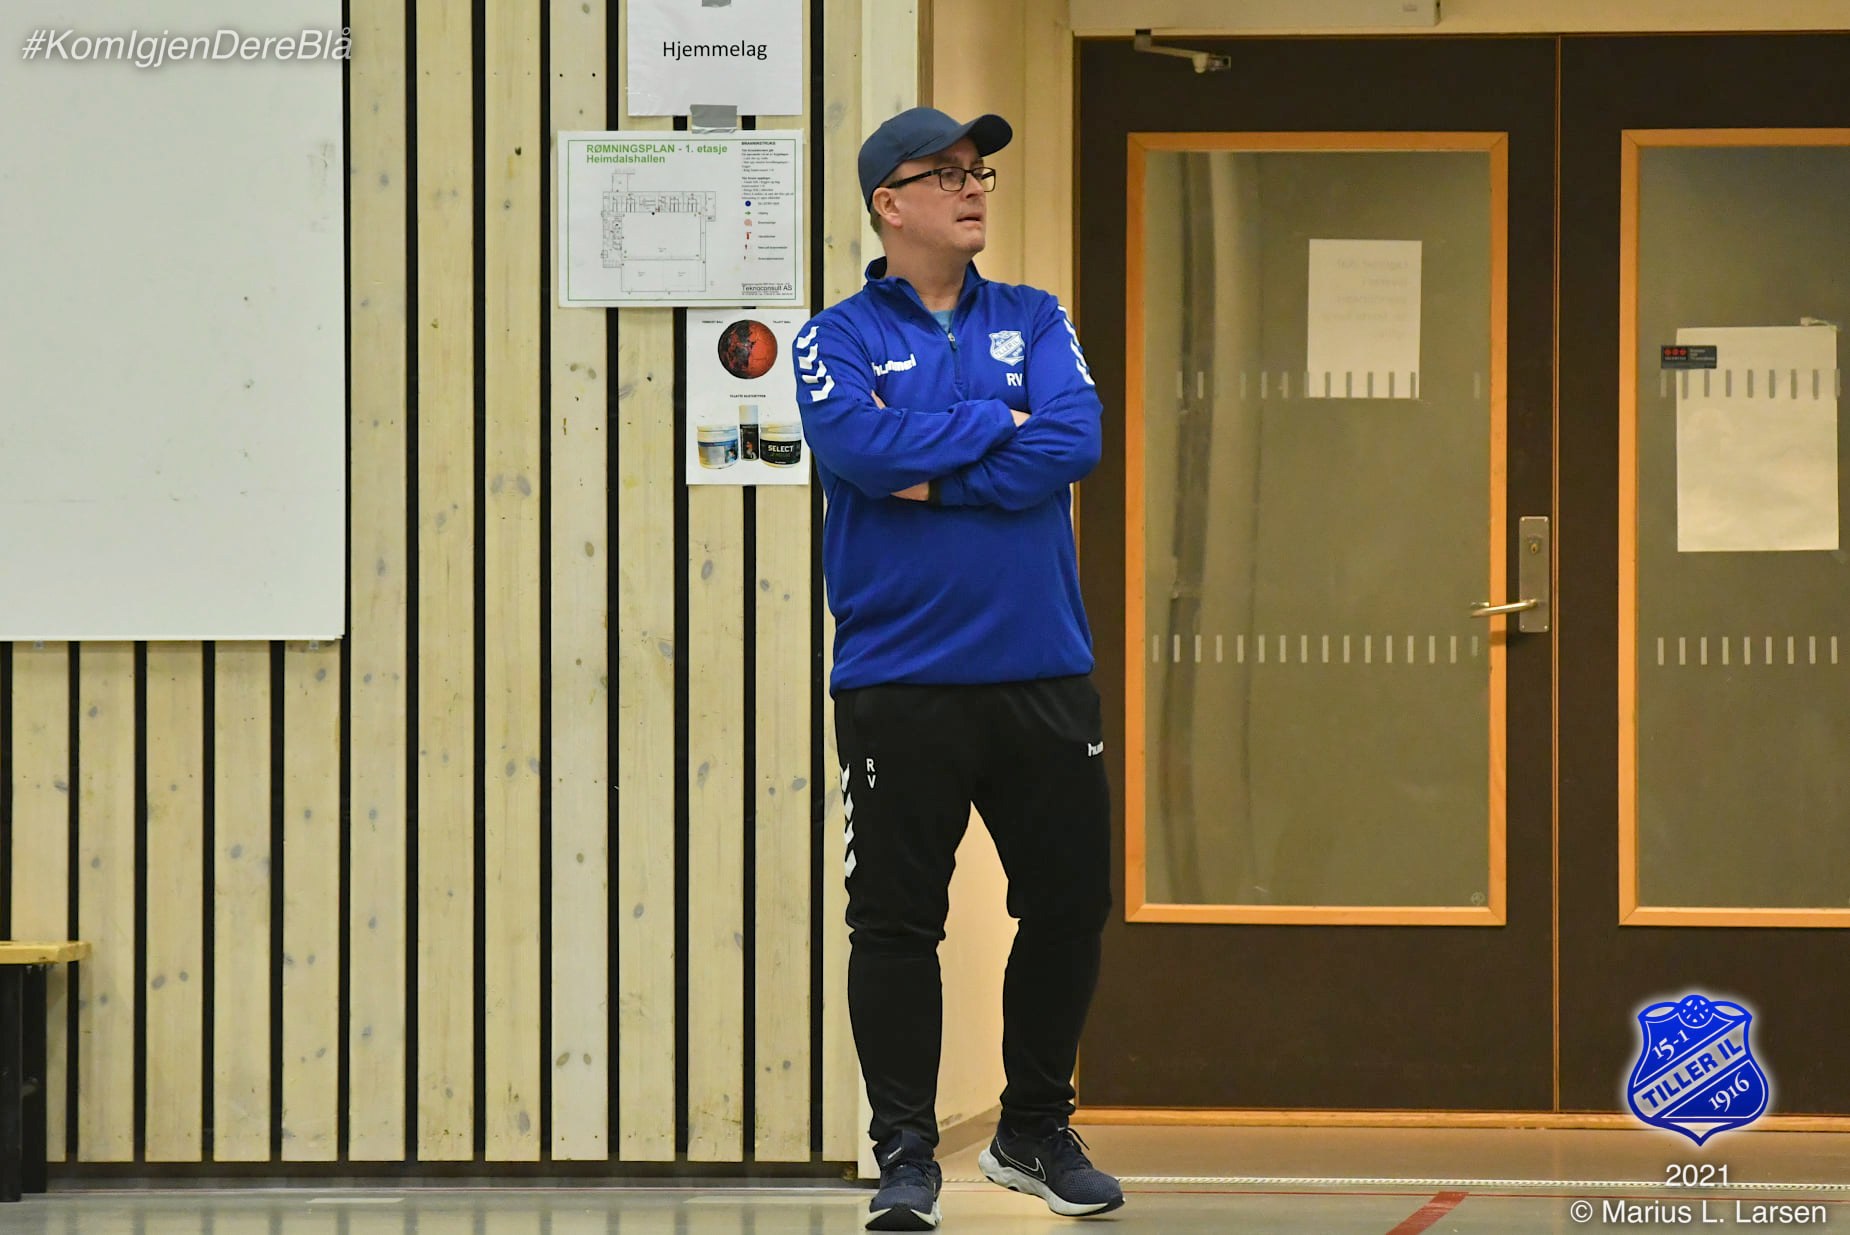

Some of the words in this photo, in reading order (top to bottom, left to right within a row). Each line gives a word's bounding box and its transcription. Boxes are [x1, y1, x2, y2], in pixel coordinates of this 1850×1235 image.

[663, 40, 767, 60] Hjemmelag
[586, 144, 675, 153] RØMNINGSPLAN
[697, 144, 728, 155] etasje
[586, 155, 665, 163] Heimdalshallen
[871, 353, 917, 377] hummel
[1006, 372, 1023, 386] RV
